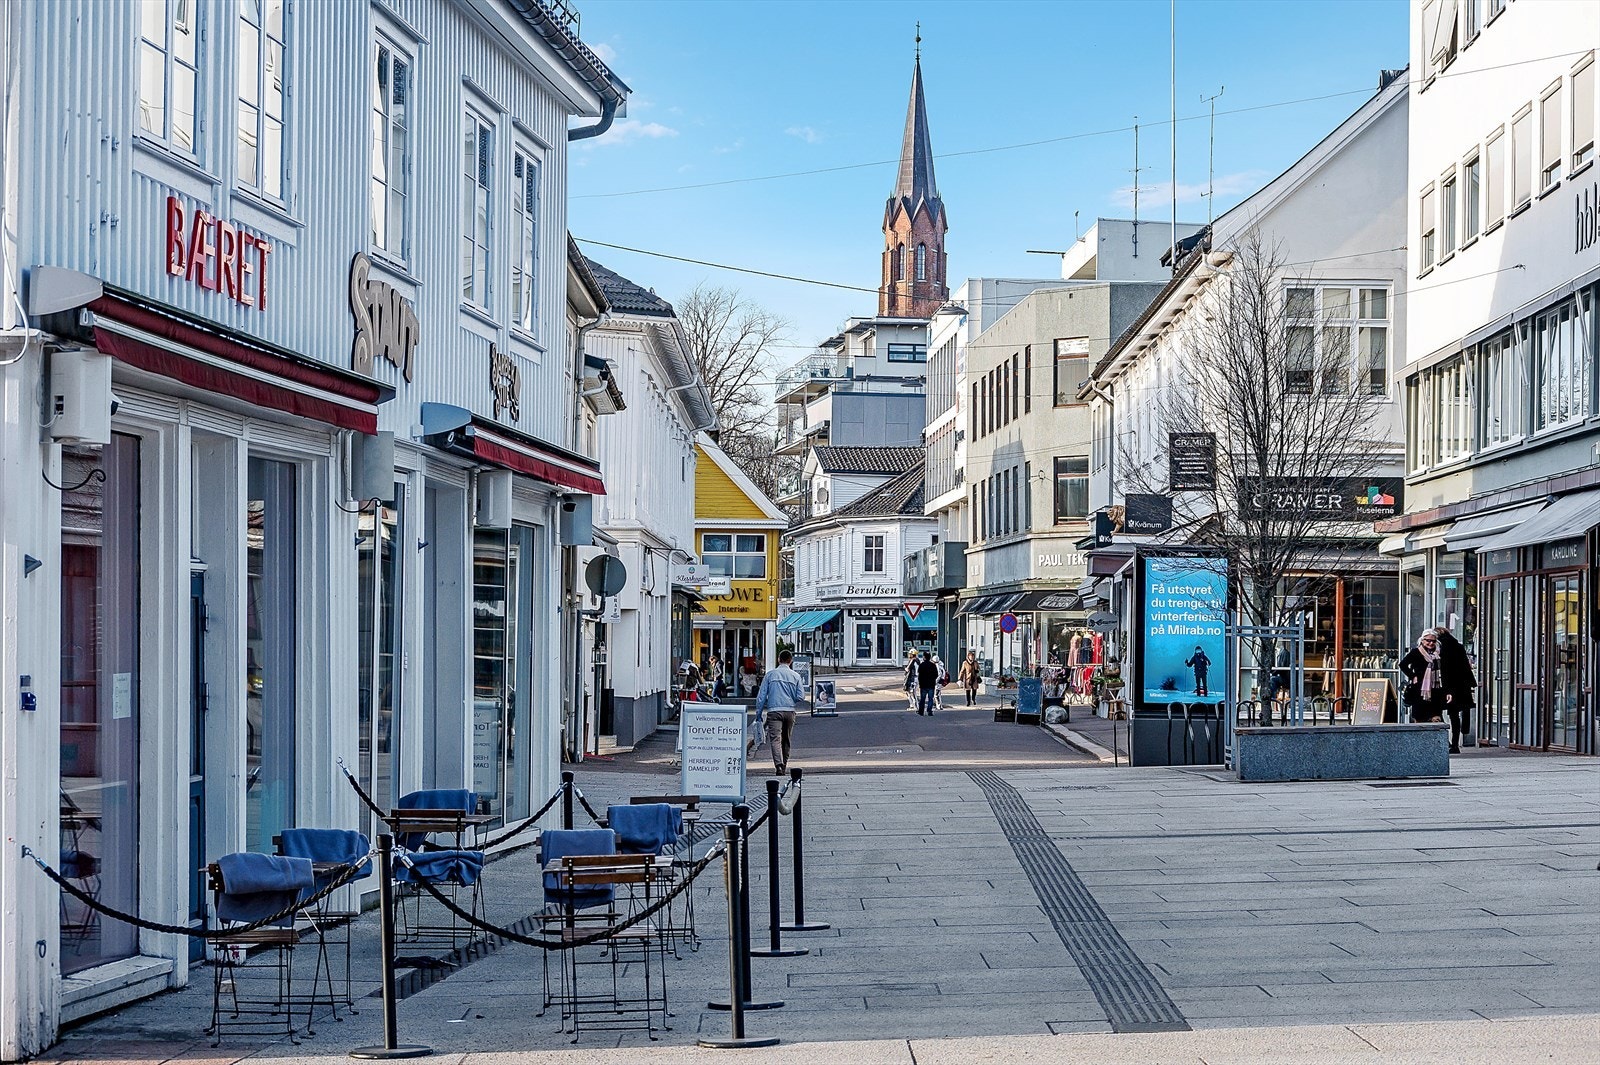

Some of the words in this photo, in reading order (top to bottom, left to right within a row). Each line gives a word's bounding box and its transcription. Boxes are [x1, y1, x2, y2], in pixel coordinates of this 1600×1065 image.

[166, 195, 272, 312] BÆRET
[349, 252, 420, 383] STAUT
[1038, 554, 1063, 567] PAUL
[1066, 553, 1088, 566] TEK
[767, 578, 777, 587] 42
[845, 585, 897, 597] Berulfsen
[1151, 583, 1165, 594] Få
[1167, 585, 1212, 596] utstyret
[1151, 598, 1165, 608] du
[1167, 599, 1208, 610] trenger
[851, 608, 895, 616] KUNST
[1151, 612, 1216, 622] vinterferien
[1151, 624, 1165, 636] på
[1167, 624, 1221, 636] Milrab.no
[687, 725, 716, 735] Torvet
[717, 725, 742, 735] Frisør
